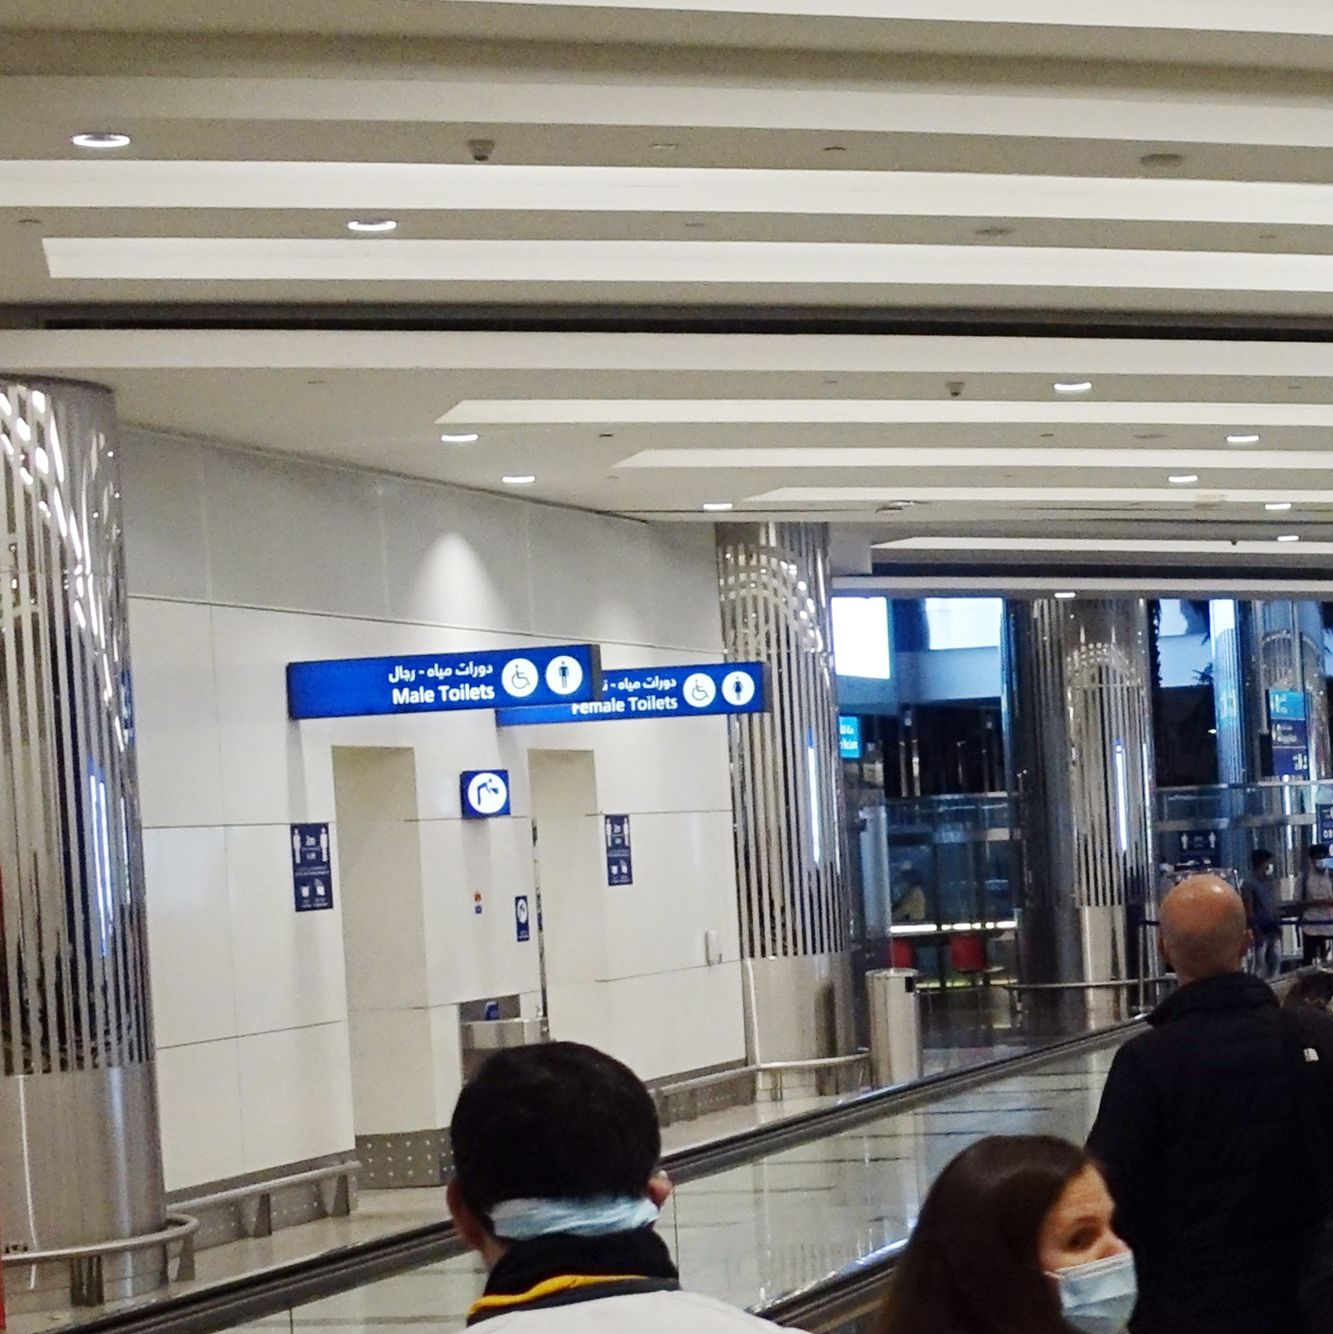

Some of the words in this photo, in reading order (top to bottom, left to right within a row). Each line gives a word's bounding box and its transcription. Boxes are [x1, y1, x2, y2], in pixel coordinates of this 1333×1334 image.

[388, 665, 416, 683] رجال
[427, 663, 453, 680] مياه
[455, 661, 493, 678] دورات
[618, 677, 641, 692] مياه
[642, 676, 677, 691] دورات
[392, 686, 435, 705] Male
[438, 683, 495, 702] Toilets
[627, 695, 678, 711] Toilets
